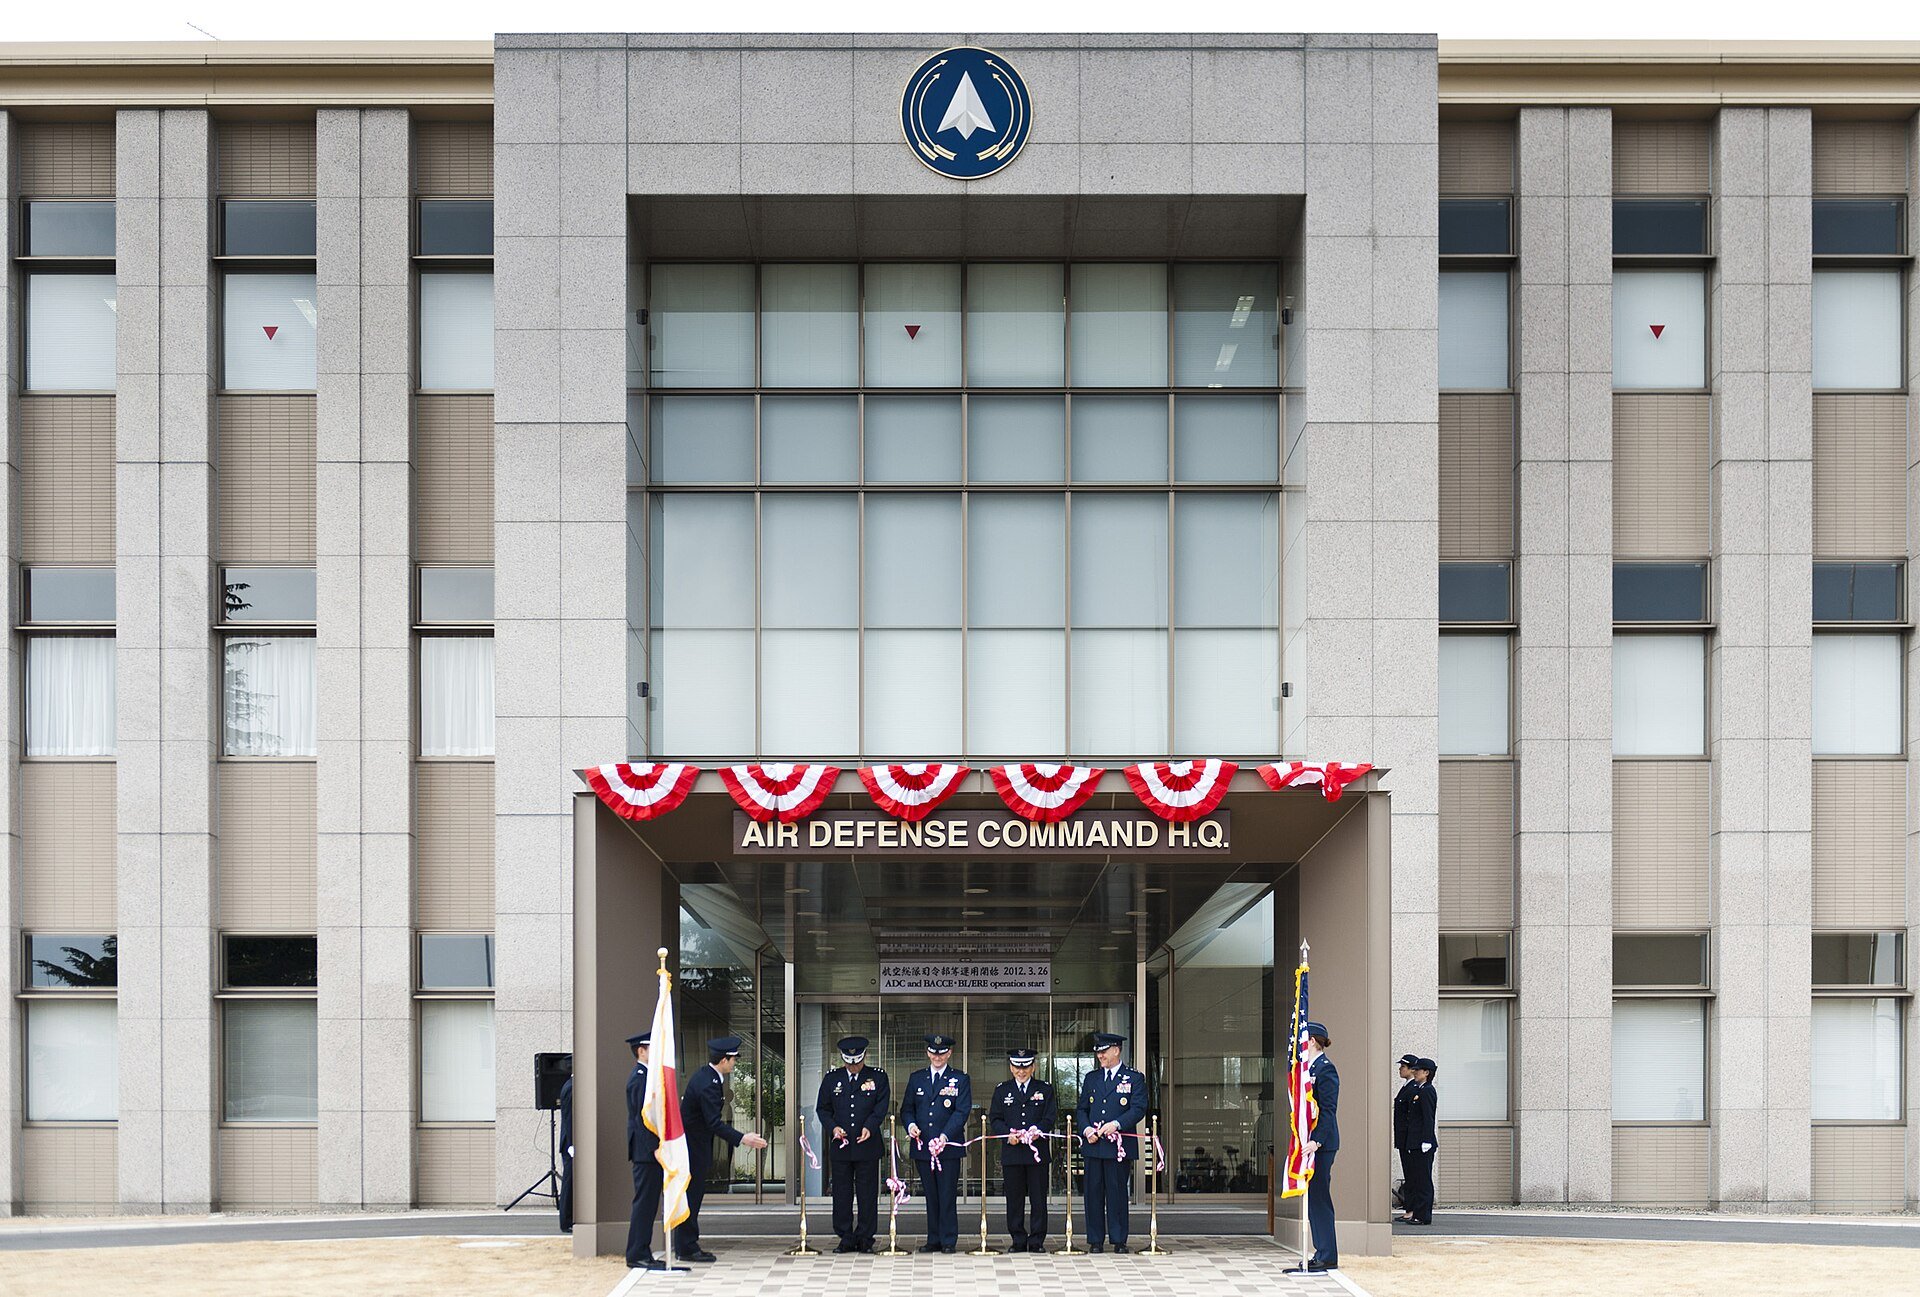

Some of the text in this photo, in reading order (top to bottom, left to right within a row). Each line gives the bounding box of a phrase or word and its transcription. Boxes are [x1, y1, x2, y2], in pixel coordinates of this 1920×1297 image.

[741, 820, 1229, 849] AIR DEFENSE COMMAND H.Q.
[885, 979, 906, 988] ADC
[907, 979, 922, 988] and
[989, 979, 1027, 989] operation
[1027, 979, 1046, 988] start
